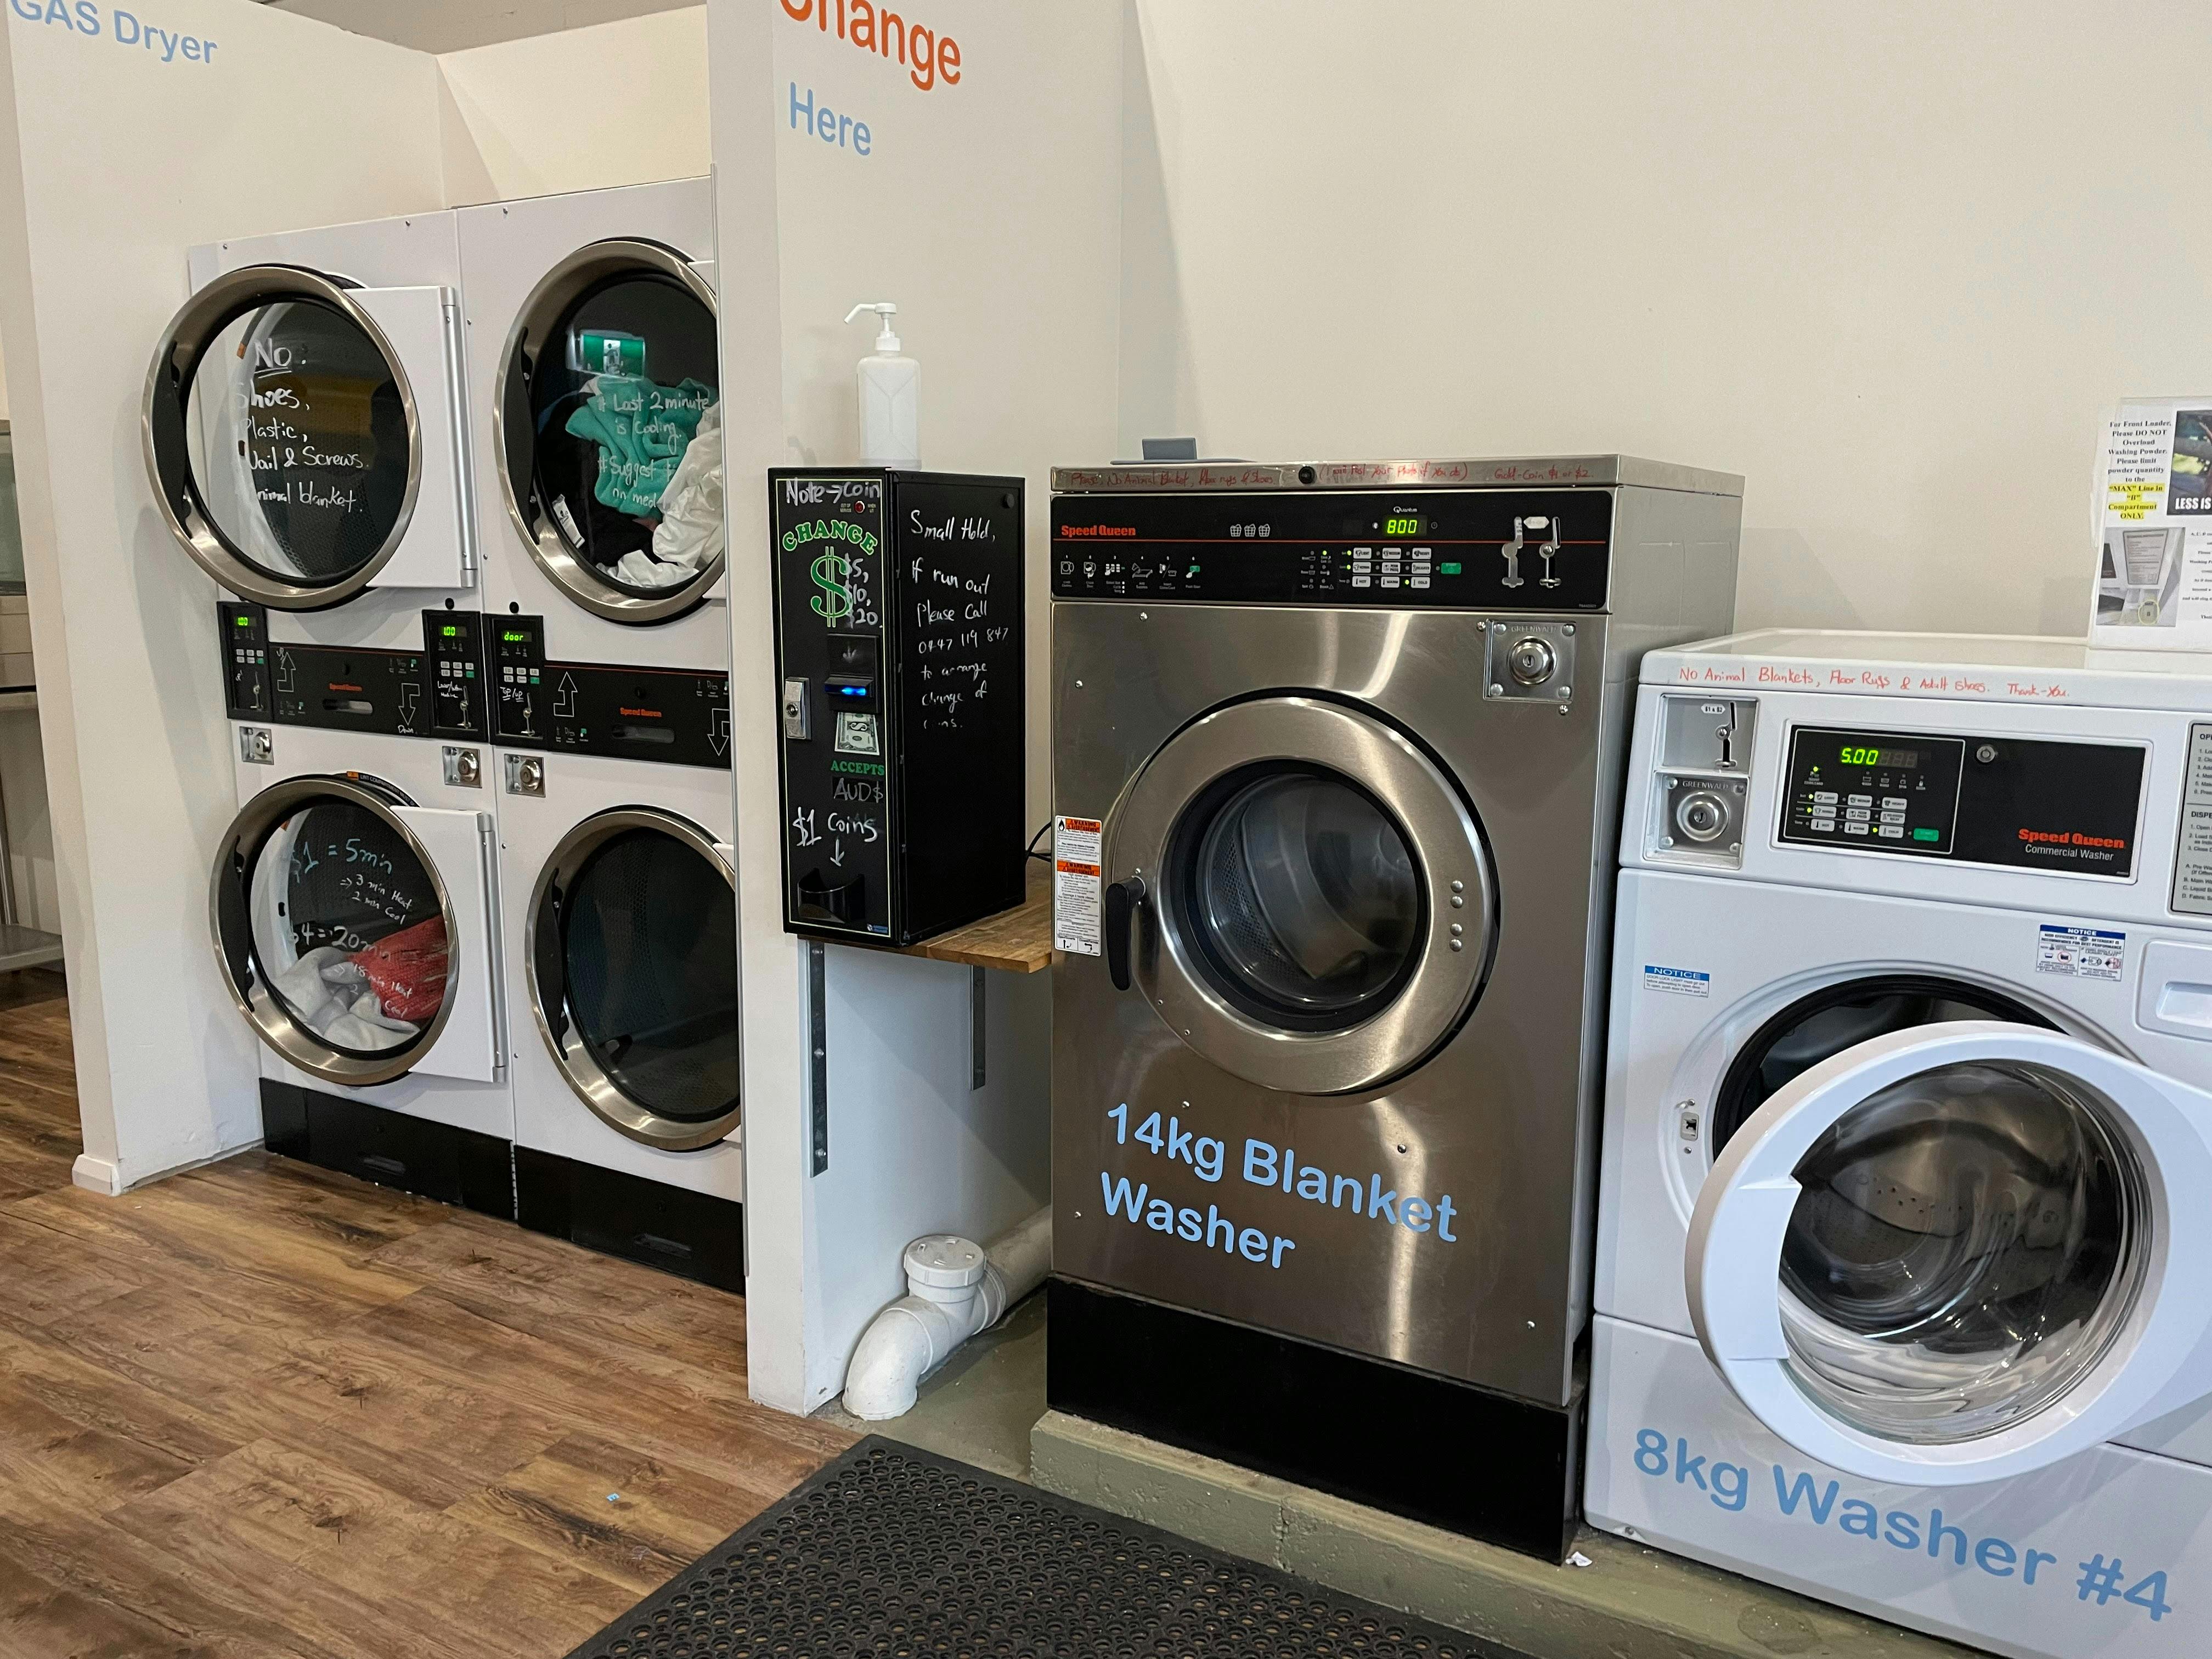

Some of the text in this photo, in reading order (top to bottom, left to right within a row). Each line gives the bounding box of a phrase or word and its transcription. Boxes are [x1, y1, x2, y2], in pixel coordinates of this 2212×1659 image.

[10, 0, 218, 63] GAS Dryer
[790, 81, 871, 156] Here
[613, 390, 710, 412] Last 2 minute
[785, 476, 881, 506] Note Coin
[1107, 472, 1122, 487] No
[256, 482, 291, 504] nimal
[2175, 497, 2211, 510] LESS IS
[910, 509, 955, 540] Small
[1061, 524, 1136, 538] Speed Queen
[1387, 520, 1418, 534] 800
[782, 520, 878, 555] CHANGE
[933, 569, 959, 589] run
[966, 573, 990, 595] out
[917, 599, 988, 628] Please Call
[504, 631, 524, 641] door
[961, 629, 978, 648] 119
[986, 627, 1009, 642] 847
[1679, 667, 1698, 681] No
[1705, 667, 1746, 682] Animal
[1758, 666, 1821, 687] Blankets,
[1900, 676, 1910, 691] &
[1920, 676, 1949, 691] Adult
[830, 759, 885, 776] ACCEPTS
[1841, 747, 1878, 765] 5.00
[792, 806, 878, 847] $1 Coins
[2018, 828, 2125, 849] Speed Queen
[2025, 844, 2114, 862] Commercial Washer
[356, 873, 413, 910] 3 min Heat
[351, 890, 360, 901] 2
[385, 906, 407, 926] Cool
[1654, 967, 1701, 979] NOTICE
[1108, 1103, 1457, 1242] 14kg Blanket
[1101, 1171, 1295, 1268] Washer
[1634, 1428, 2172, 1623] 8kg Washer #4
